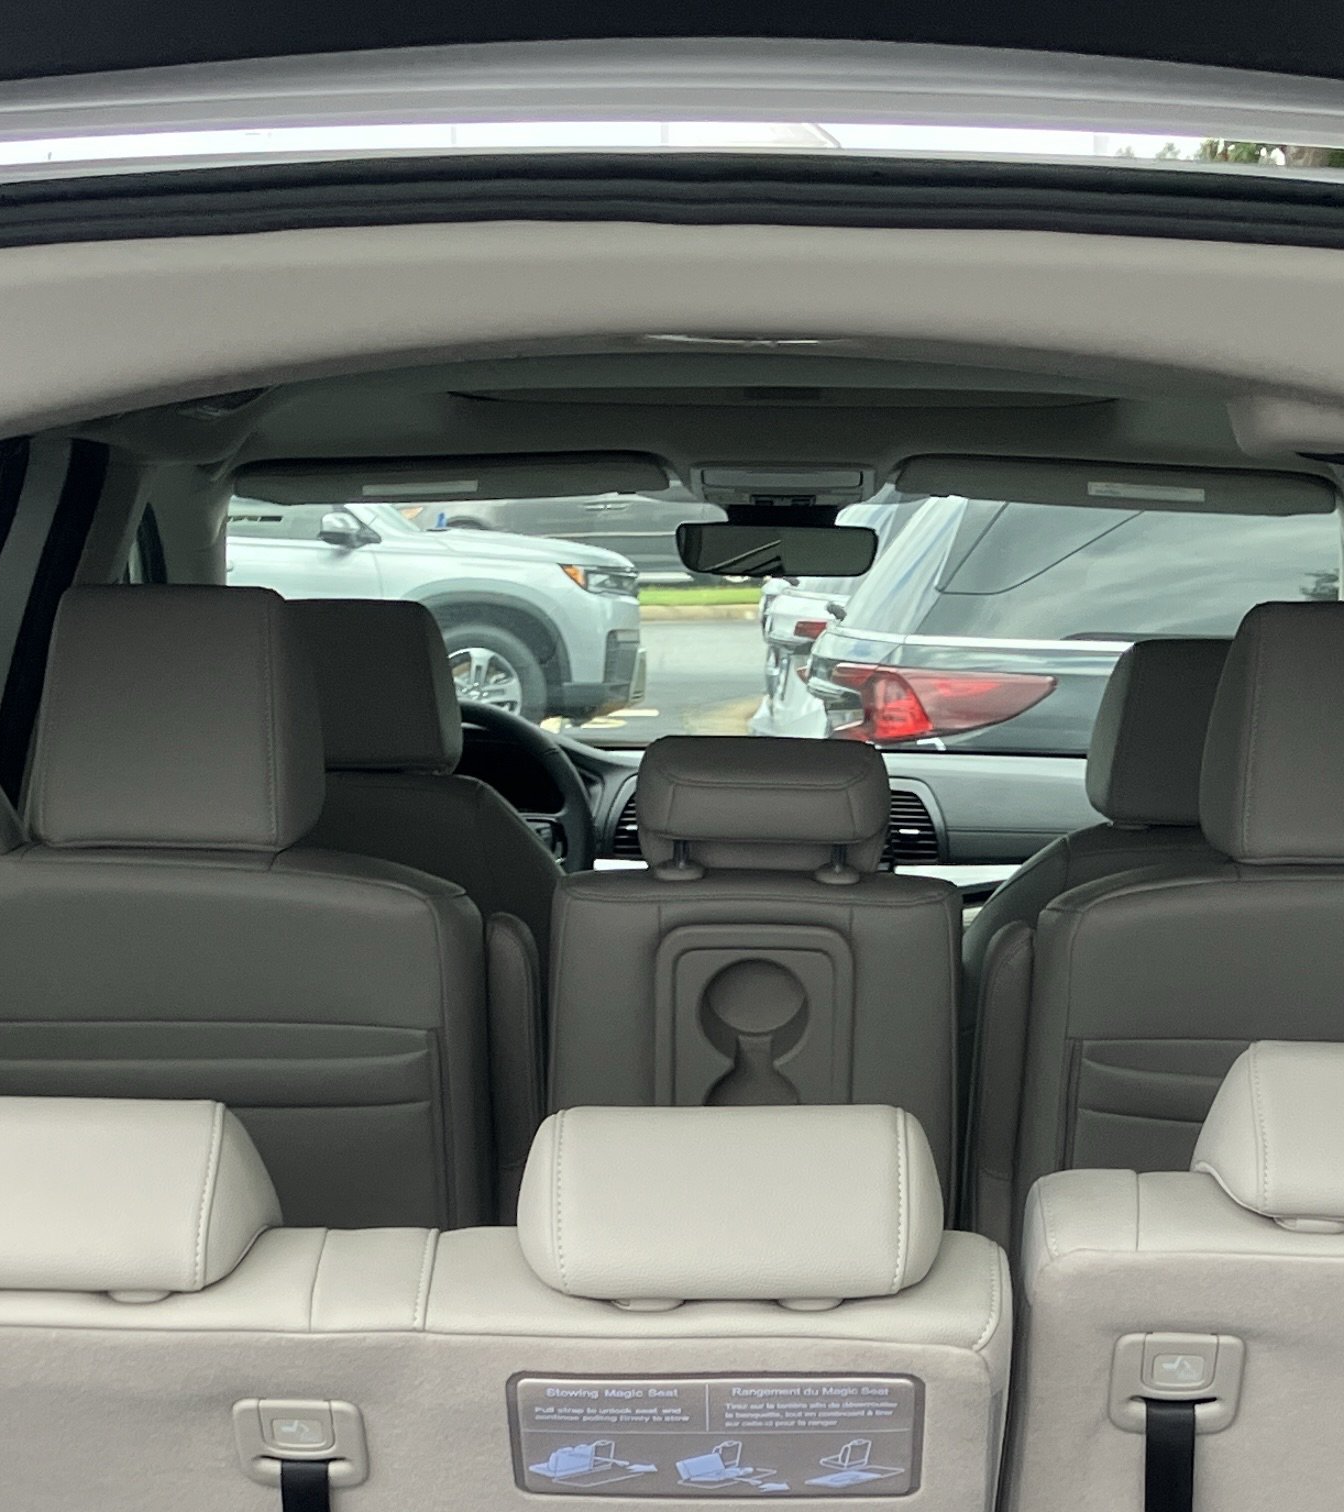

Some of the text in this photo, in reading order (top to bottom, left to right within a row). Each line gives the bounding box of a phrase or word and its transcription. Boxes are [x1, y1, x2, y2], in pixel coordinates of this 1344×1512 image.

[546, 1388, 679, 1399] Stowing Magic Seat
[731, 1387, 889, 1397] Rangement du Magic Seat
